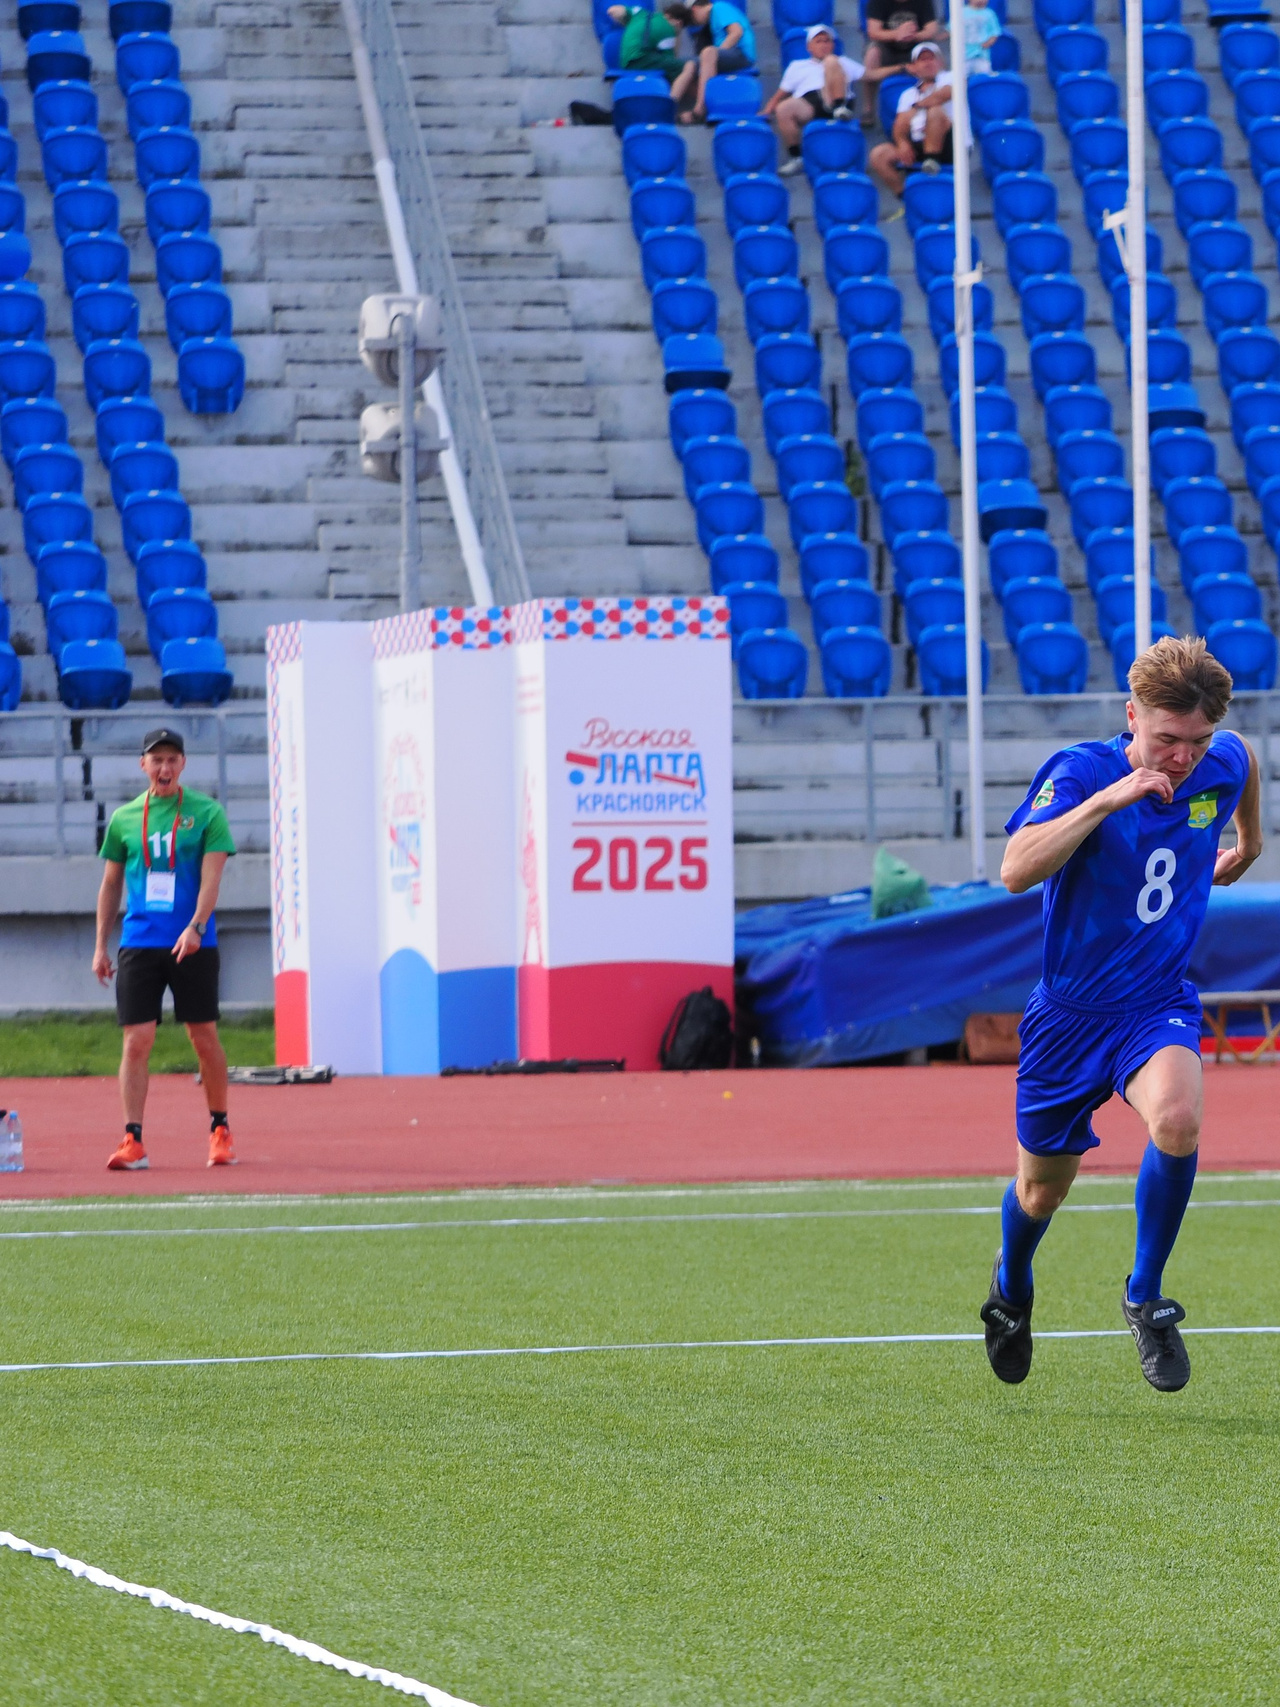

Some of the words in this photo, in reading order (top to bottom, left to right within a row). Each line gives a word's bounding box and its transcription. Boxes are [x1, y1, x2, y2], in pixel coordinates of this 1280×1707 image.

[580, 717, 696, 749] Русская
[595, 752, 706, 797] ЛАПТА
[577, 793, 707, 813] КРАСНОЯРСК
[148, 831, 173, 858] 11
[572, 837, 708, 892] 2025
[1136, 847, 1176, 924] 8
